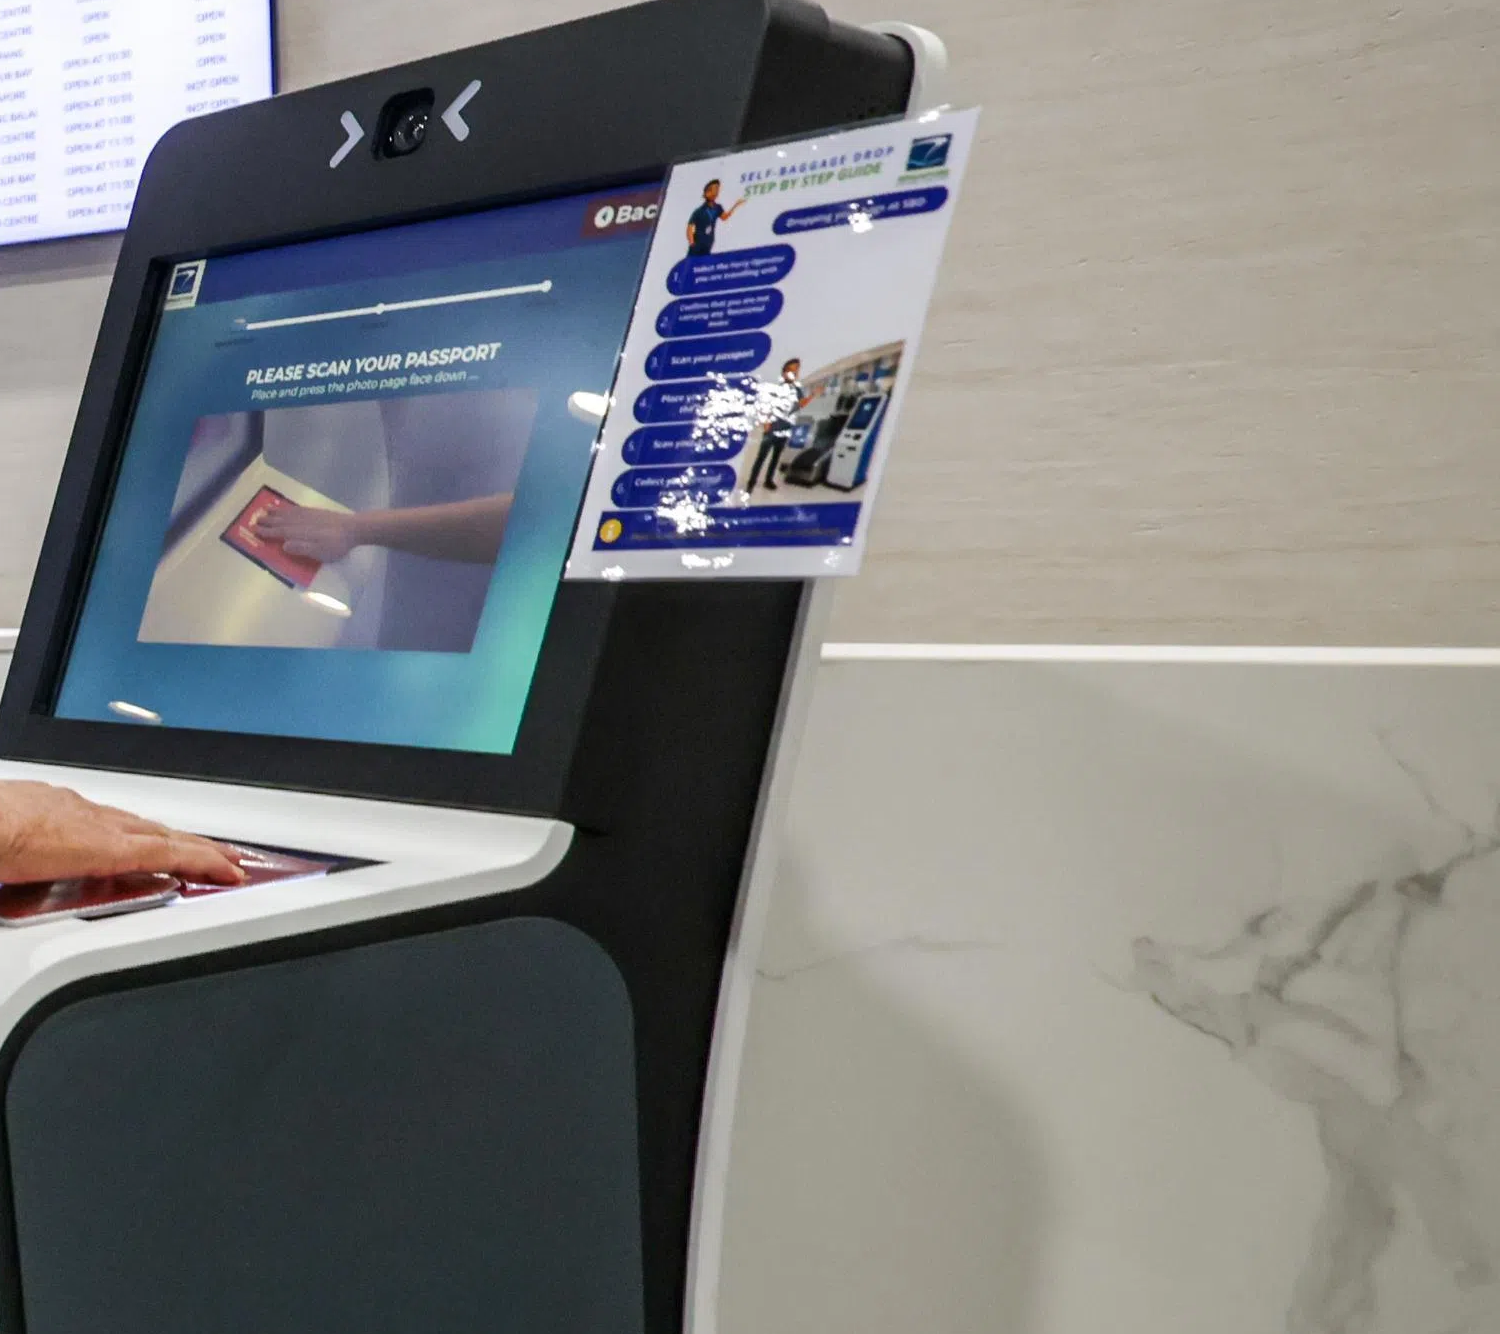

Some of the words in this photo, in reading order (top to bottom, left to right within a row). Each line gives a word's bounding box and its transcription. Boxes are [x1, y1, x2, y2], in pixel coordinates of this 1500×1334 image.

[740, 154, 848, 183] SELF-BAGGAGE
[853, 146, 895, 163] DROP
[744, 181, 777, 198] STEP
[779, 177, 798, 192] BY
[801, 171, 835, 187] STEP
[838, 162, 884, 181] GUIDE
[615, 204, 658, 224] Bac
[246, 364, 303, 385] PLEASE
[307, 359, 352, 379] SCAN
[355, 353, 401, 374] YOUR
[405, 342, 501, 369] PASSPORT
[278, 386, 298, 399] and
[300, 383, 327, 397] press
[328, 382, 345, 393] the
[346, 378, 377, 392] photo
[379, 375, 407, 390] page
[409, 372, 433, 385] face
[434, 370, 467, 383] down
